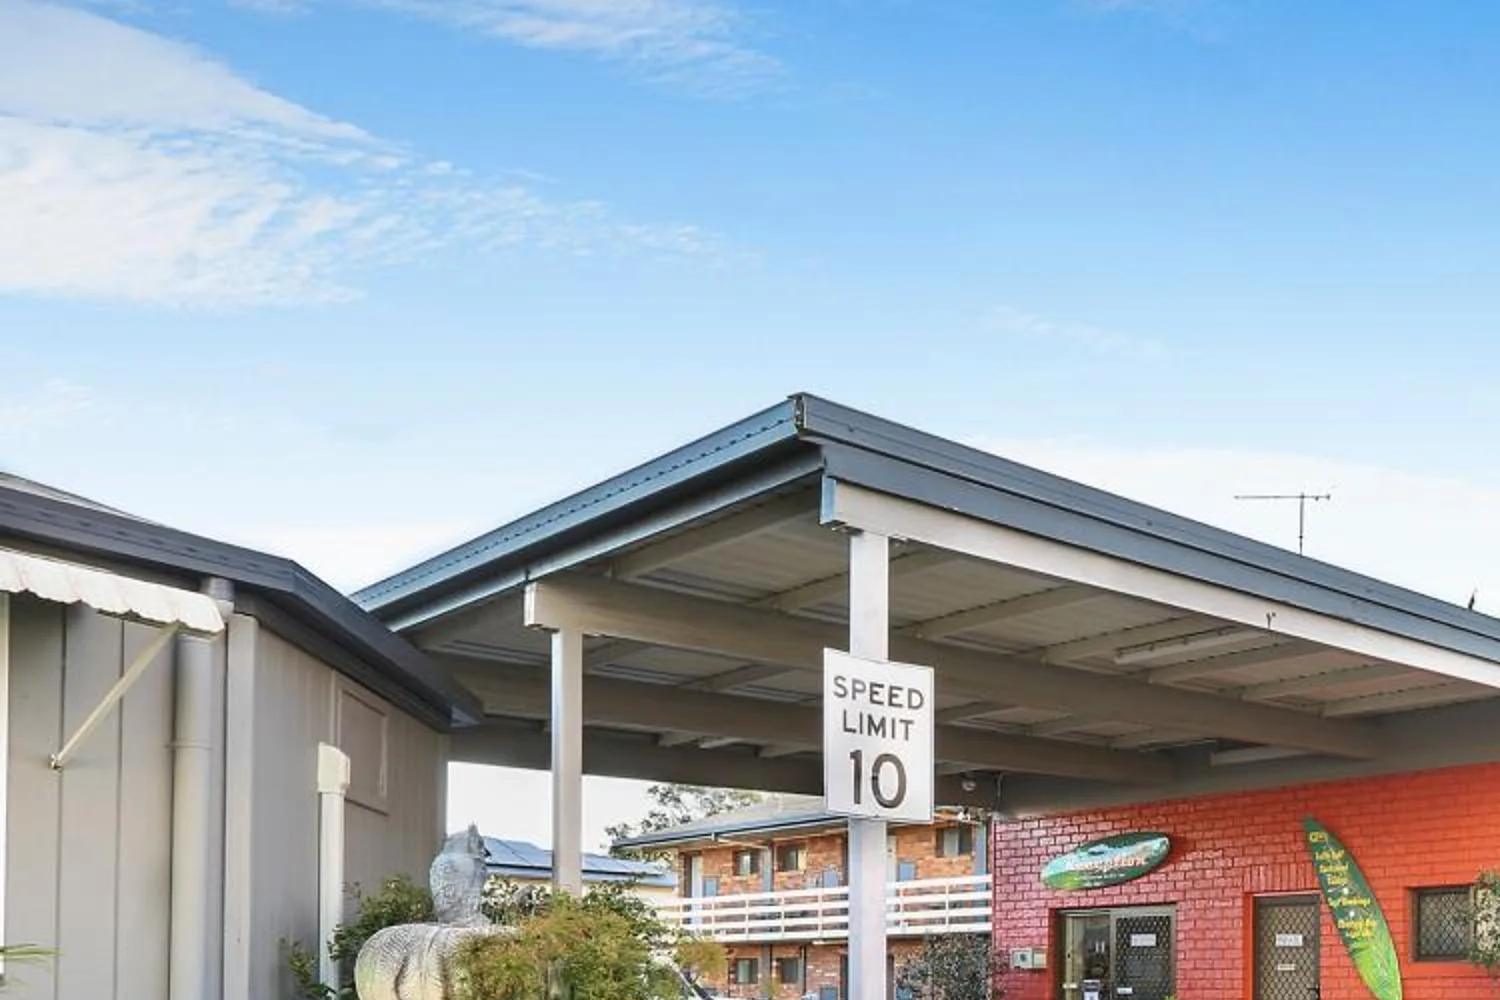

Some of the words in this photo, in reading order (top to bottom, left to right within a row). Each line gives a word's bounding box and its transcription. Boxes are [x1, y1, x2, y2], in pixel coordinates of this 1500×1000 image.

[833, 675, 925, 711] SPEED
[843, 709, 914, 741] LIMIT
[850, 749, 907, 809] 10
